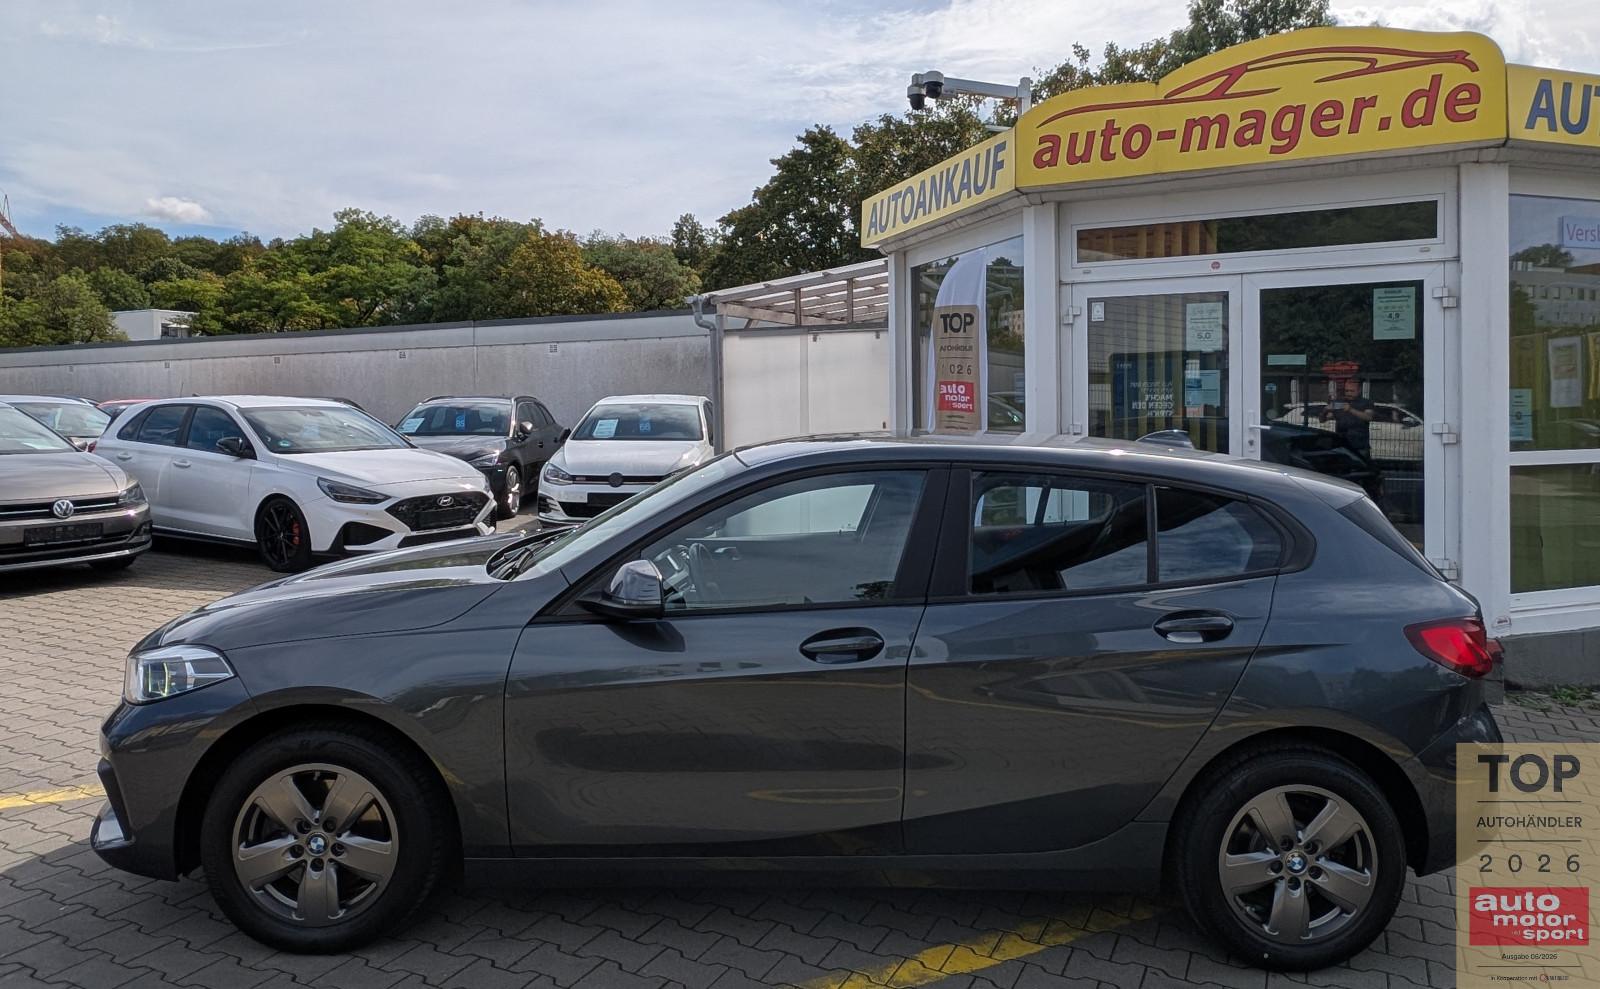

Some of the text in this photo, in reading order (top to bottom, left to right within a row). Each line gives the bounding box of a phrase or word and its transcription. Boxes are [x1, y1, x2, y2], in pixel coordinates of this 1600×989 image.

[1033, 73, 1481, 169] auto-mager.de
[867, 141, 1007, 238] AUTOANKAUF
[940, 312, 975, 334] TOP
[942, 364, 972, 376] 026
